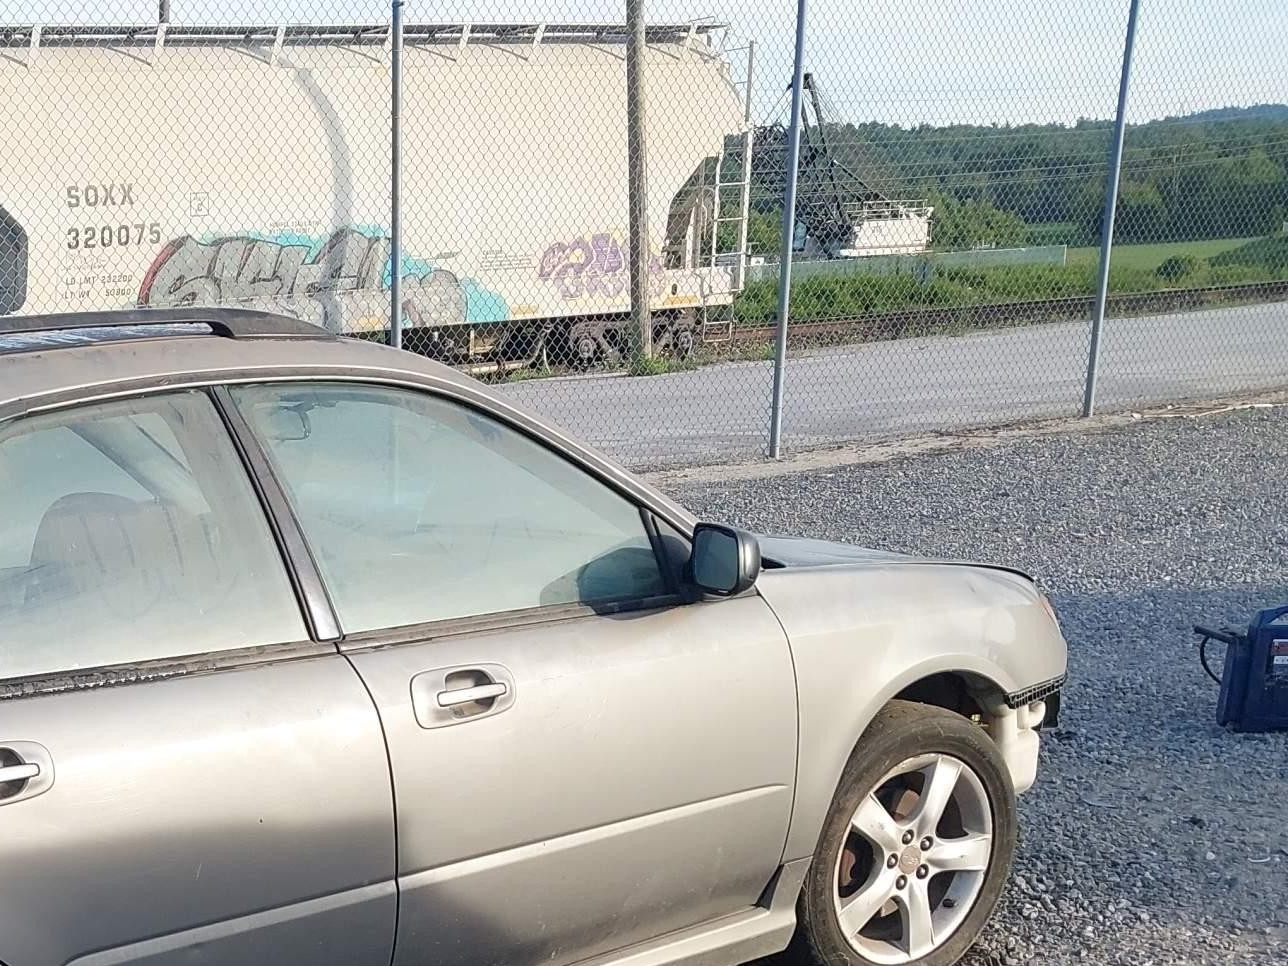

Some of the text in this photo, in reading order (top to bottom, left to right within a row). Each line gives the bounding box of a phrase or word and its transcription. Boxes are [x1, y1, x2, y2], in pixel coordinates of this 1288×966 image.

[66, 183, 135, 208] SOXX
[66, 222, 161, 250] 320075
[80, 275, 97, 285] LMT
